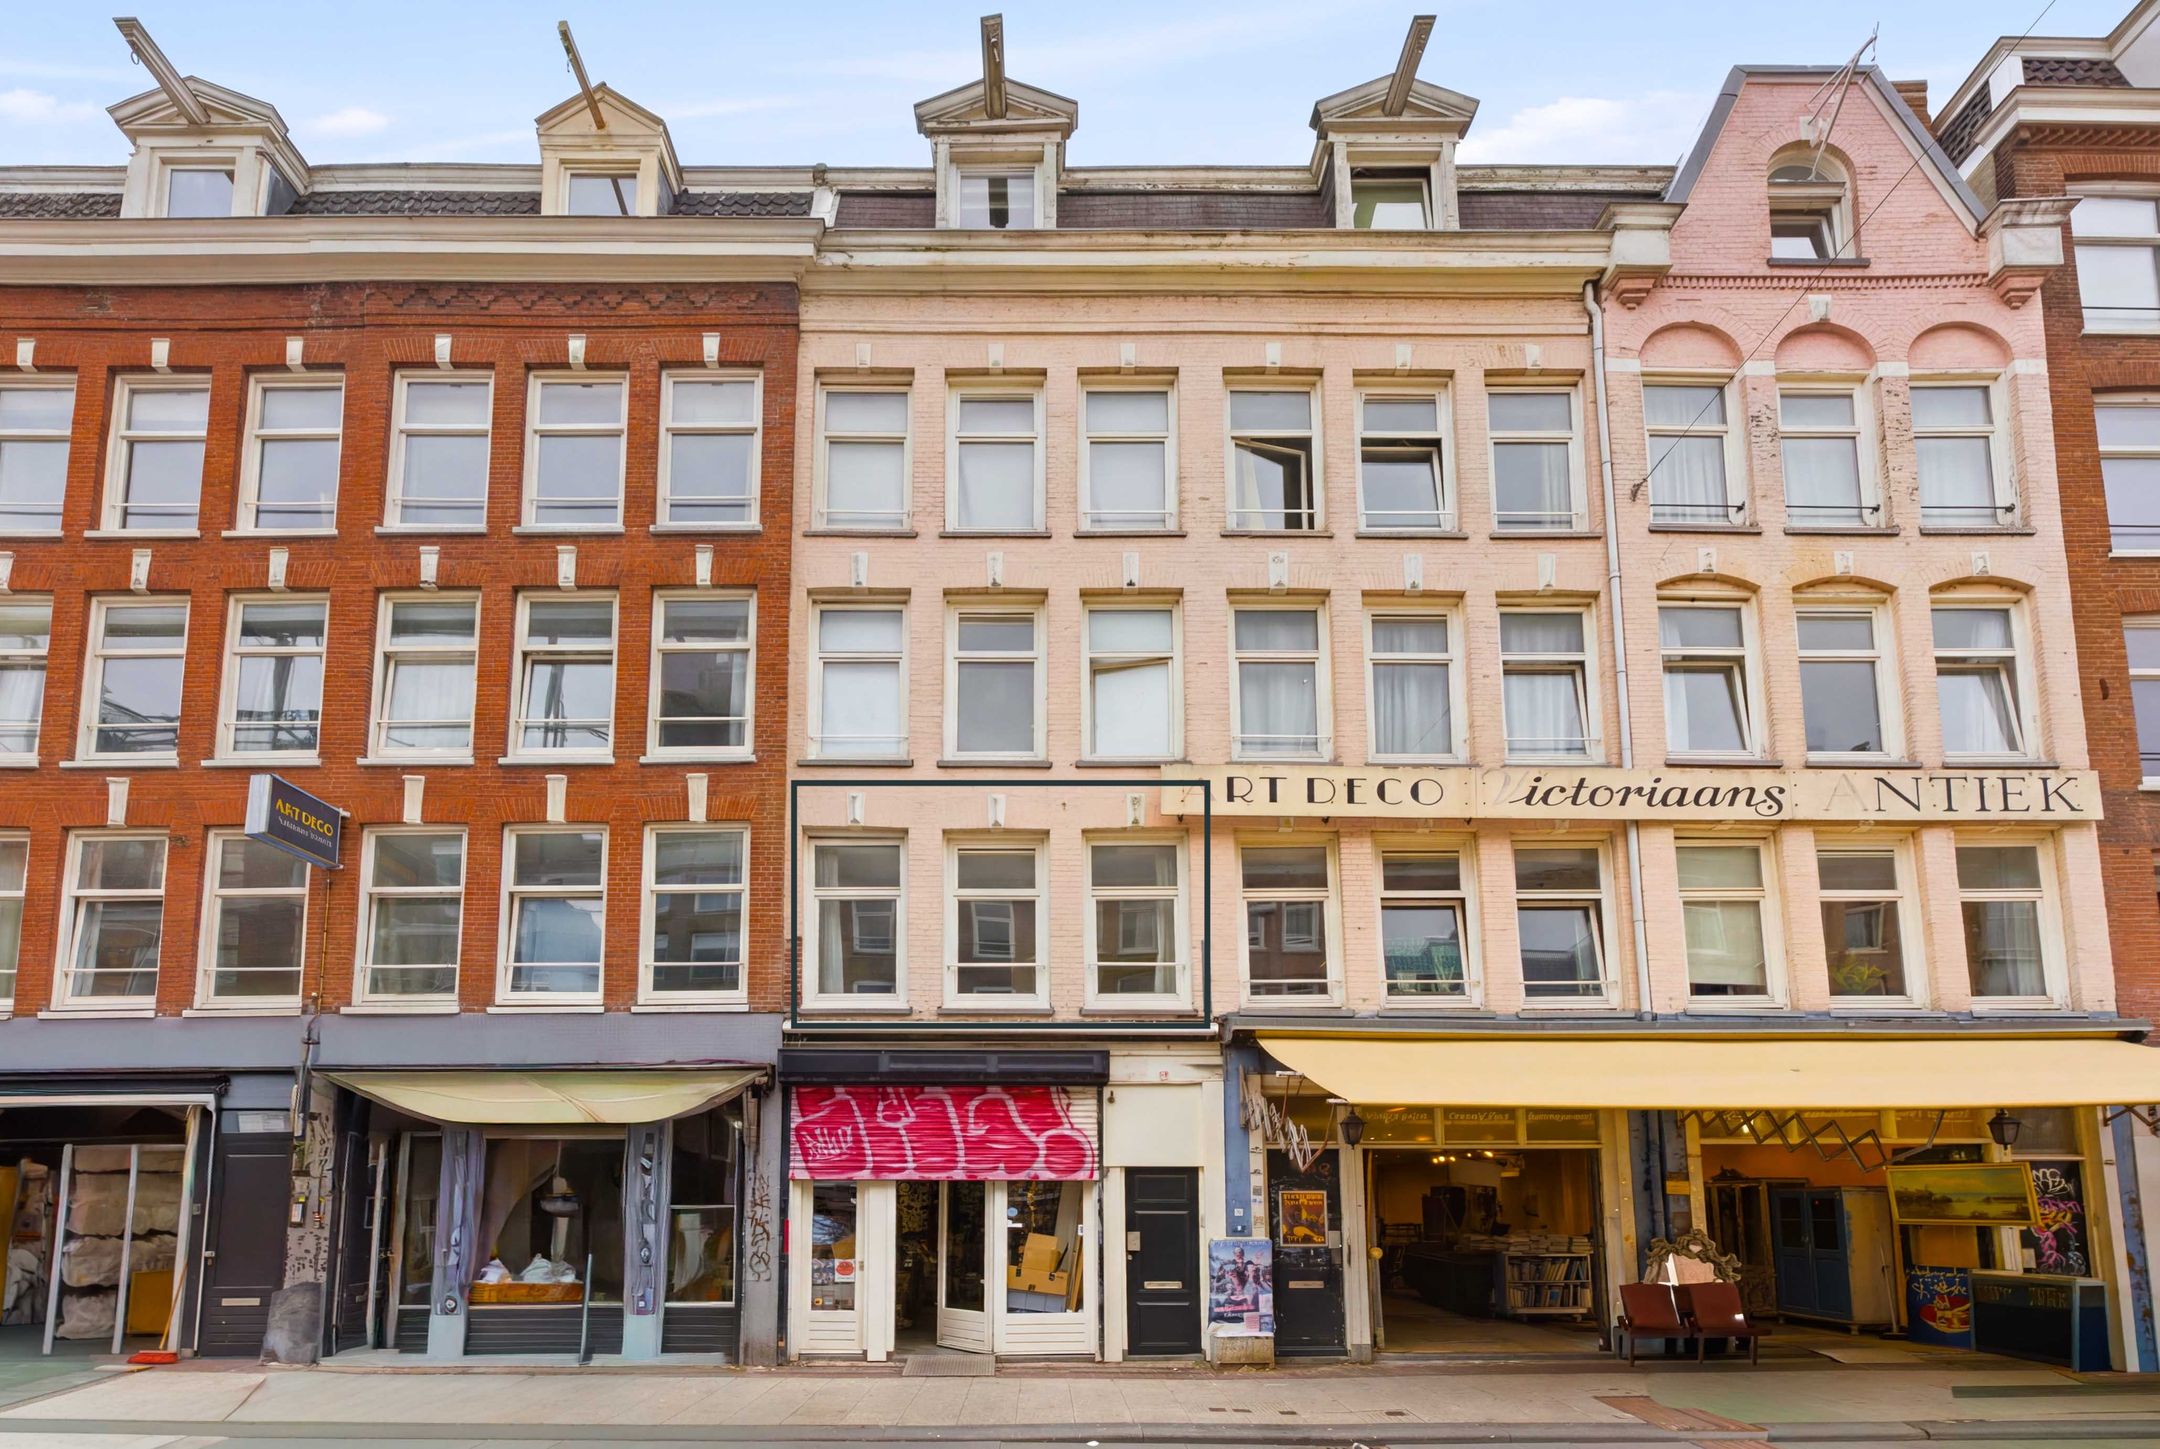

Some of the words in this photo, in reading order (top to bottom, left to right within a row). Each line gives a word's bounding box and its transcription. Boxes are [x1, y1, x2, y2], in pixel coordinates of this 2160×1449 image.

[1306, 777, 1444, 806] DECO
[1823, 773, 2084, 812] ANTIEK
[276, 799, 300, 821] ART
[302, 812, 333, 836] DECO
